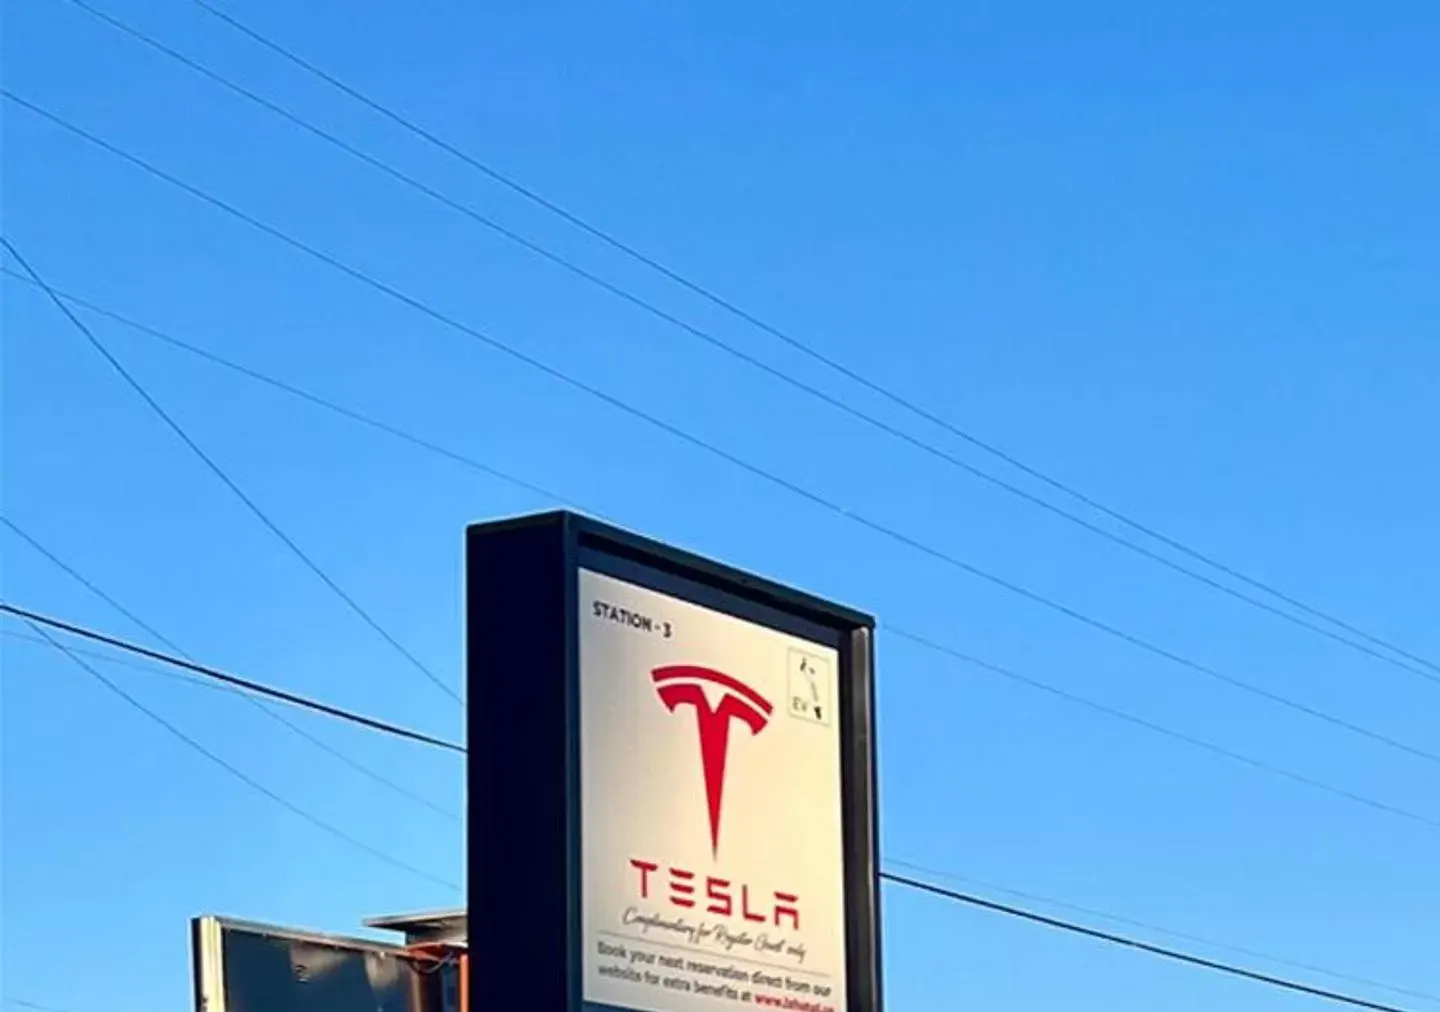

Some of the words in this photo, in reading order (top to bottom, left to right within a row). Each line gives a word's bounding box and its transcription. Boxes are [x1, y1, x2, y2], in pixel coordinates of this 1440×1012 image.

[592, 600, 652, 632] STATION
[629, 858, 800, 931] TESLA
[597, 940, 627, 958] Book
[630, 950, 656, 964] your
[659, 955, 684, 970] next
[686, 961, 749, 981] reservation
[752, 970, 783, 988] direct
[784, 976, 812, 993] from
[813, 984, 832, 997] our
[597, 964, 642, 982] website
[644, 970, 660, 985] for
[663, 977, 691, 992] extra
[694, 980, 739, 1000] benefits
[741, 990, 752, 1001] at
